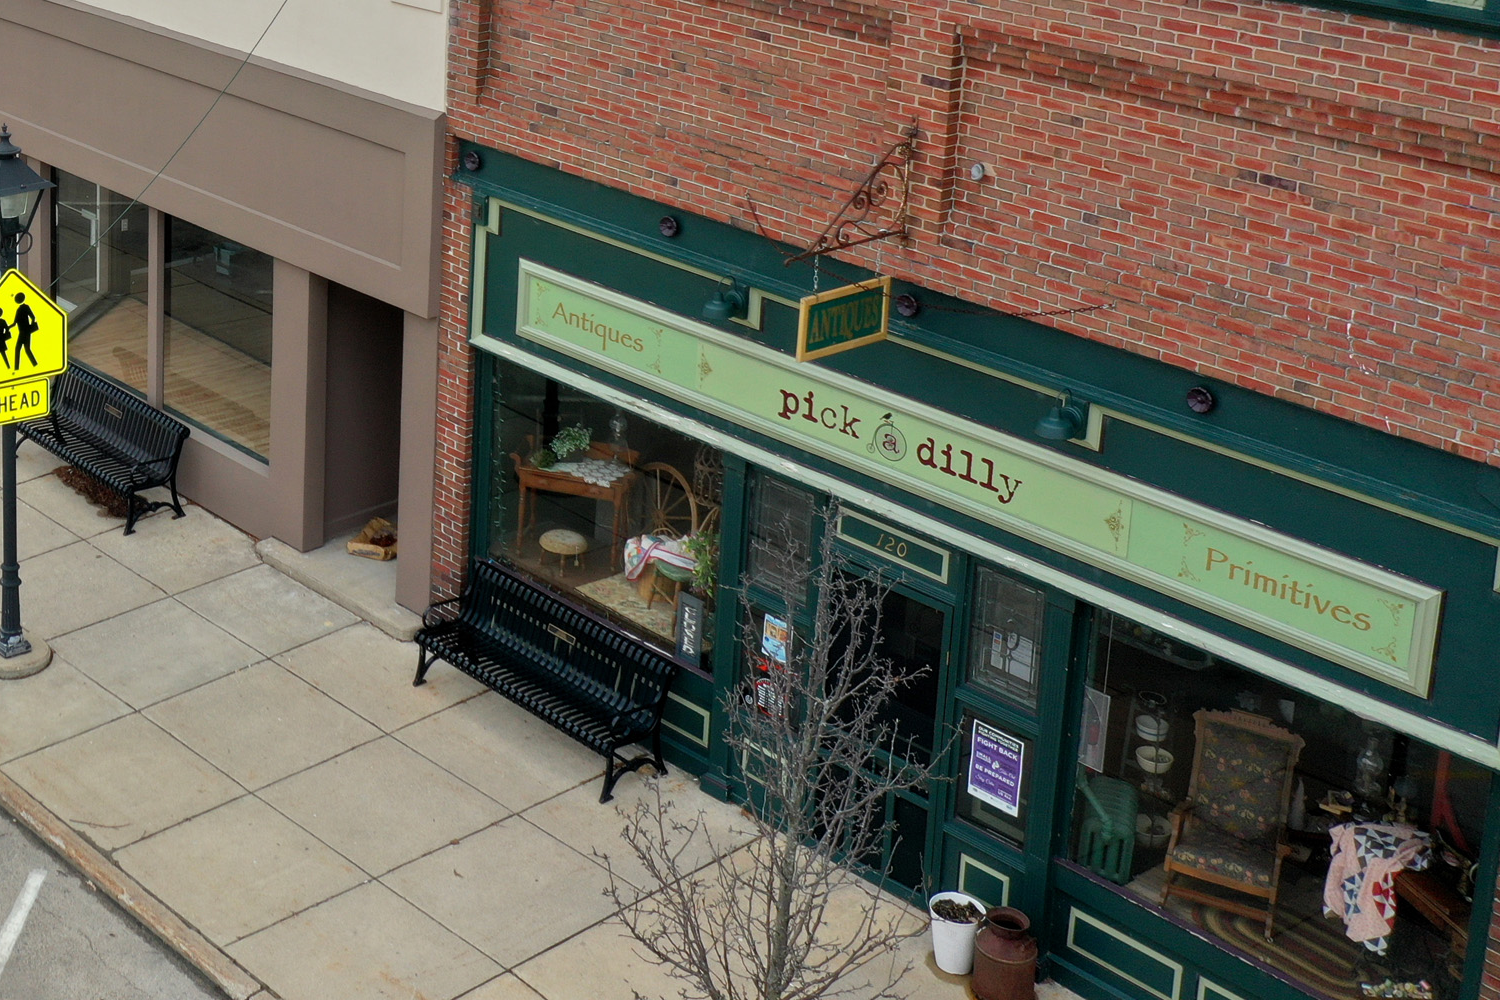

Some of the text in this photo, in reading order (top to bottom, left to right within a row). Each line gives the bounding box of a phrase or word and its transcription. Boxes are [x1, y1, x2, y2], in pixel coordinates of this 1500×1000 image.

[551, 302, 645, 353] Antiques
[809, 295, 880, 344] ANTIQUES
[777, 388, 862, 440] pick
[916, 437, 1023, 504] dilly
[876, 532, 908, 558] 120
[1205, 547, 1372, 632] Primitives
[977, 736, 998, 751] FIGHT
[998, 746, 1018, 761] BACK
[975, 763, 1015, 787] BE PREPARED
